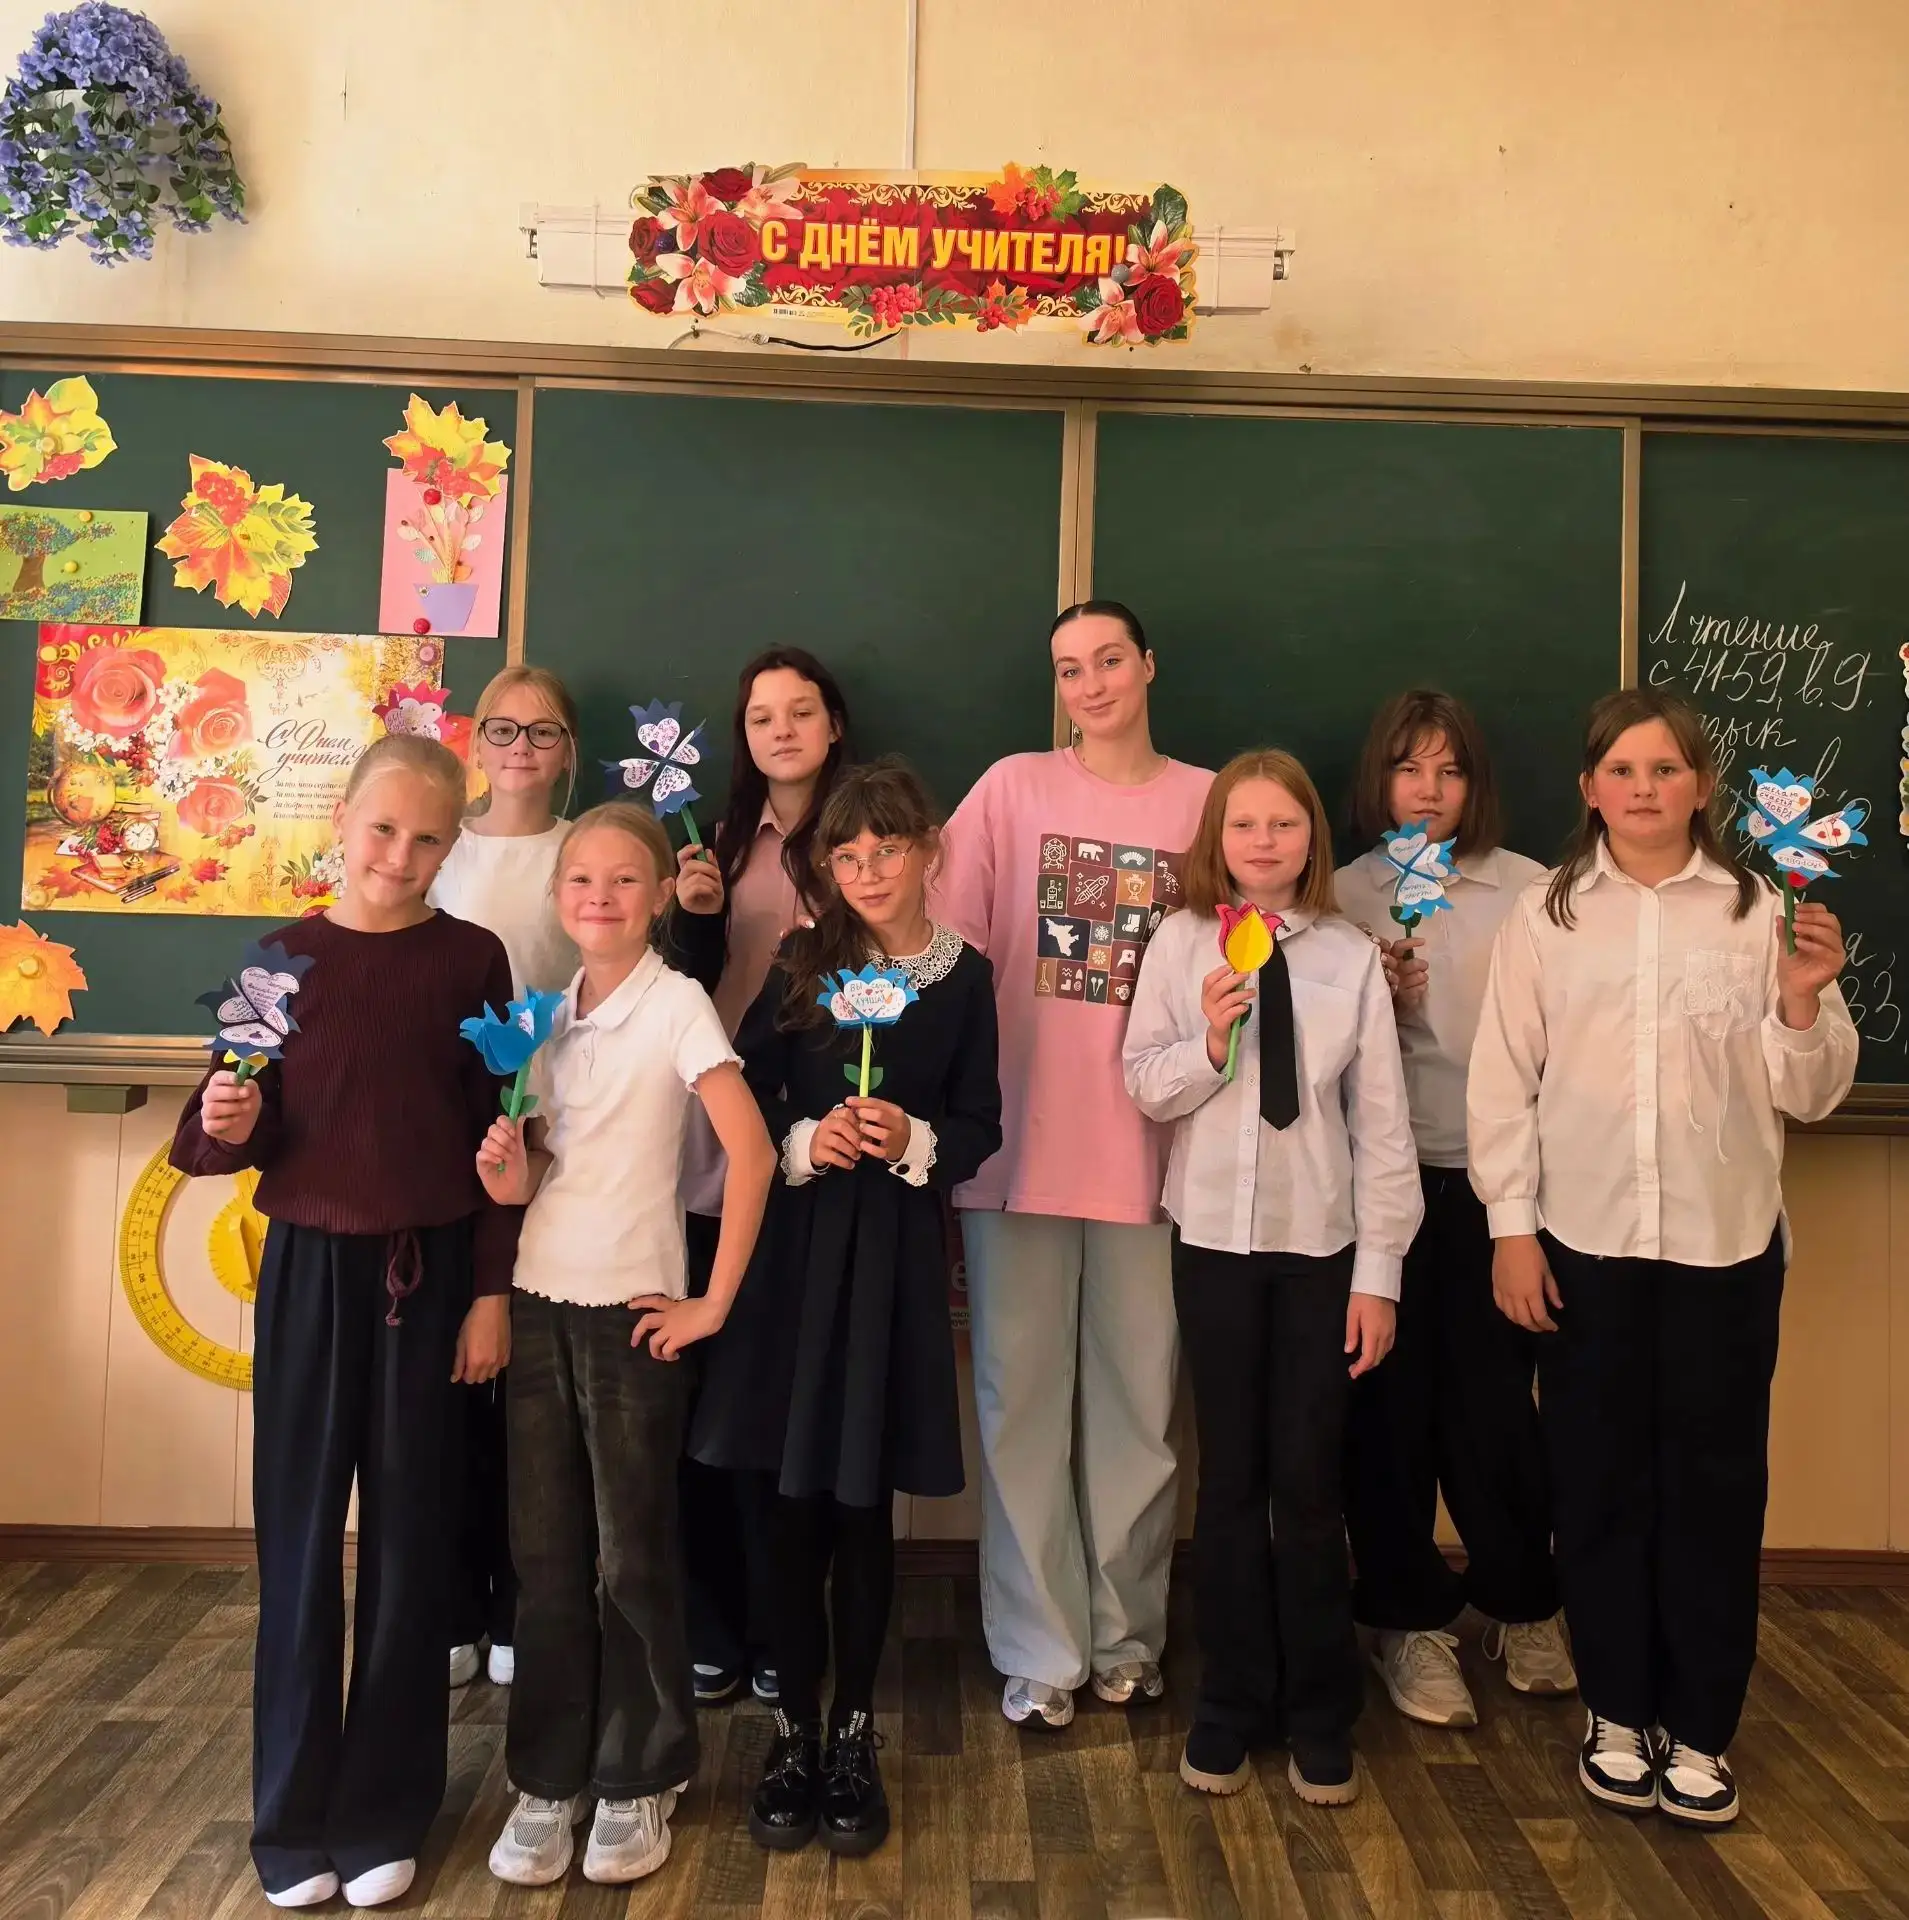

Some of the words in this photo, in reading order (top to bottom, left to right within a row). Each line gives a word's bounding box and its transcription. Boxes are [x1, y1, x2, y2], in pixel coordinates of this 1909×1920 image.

[761, 220, 789, 261] С
[800, 218, 920, 271] ДНЁМ
[931, 228, 1127, 276] УЧИТЕЛЯ!
[256, 719, 298, 749] С
[138, 1272, 146, 1283] 90
